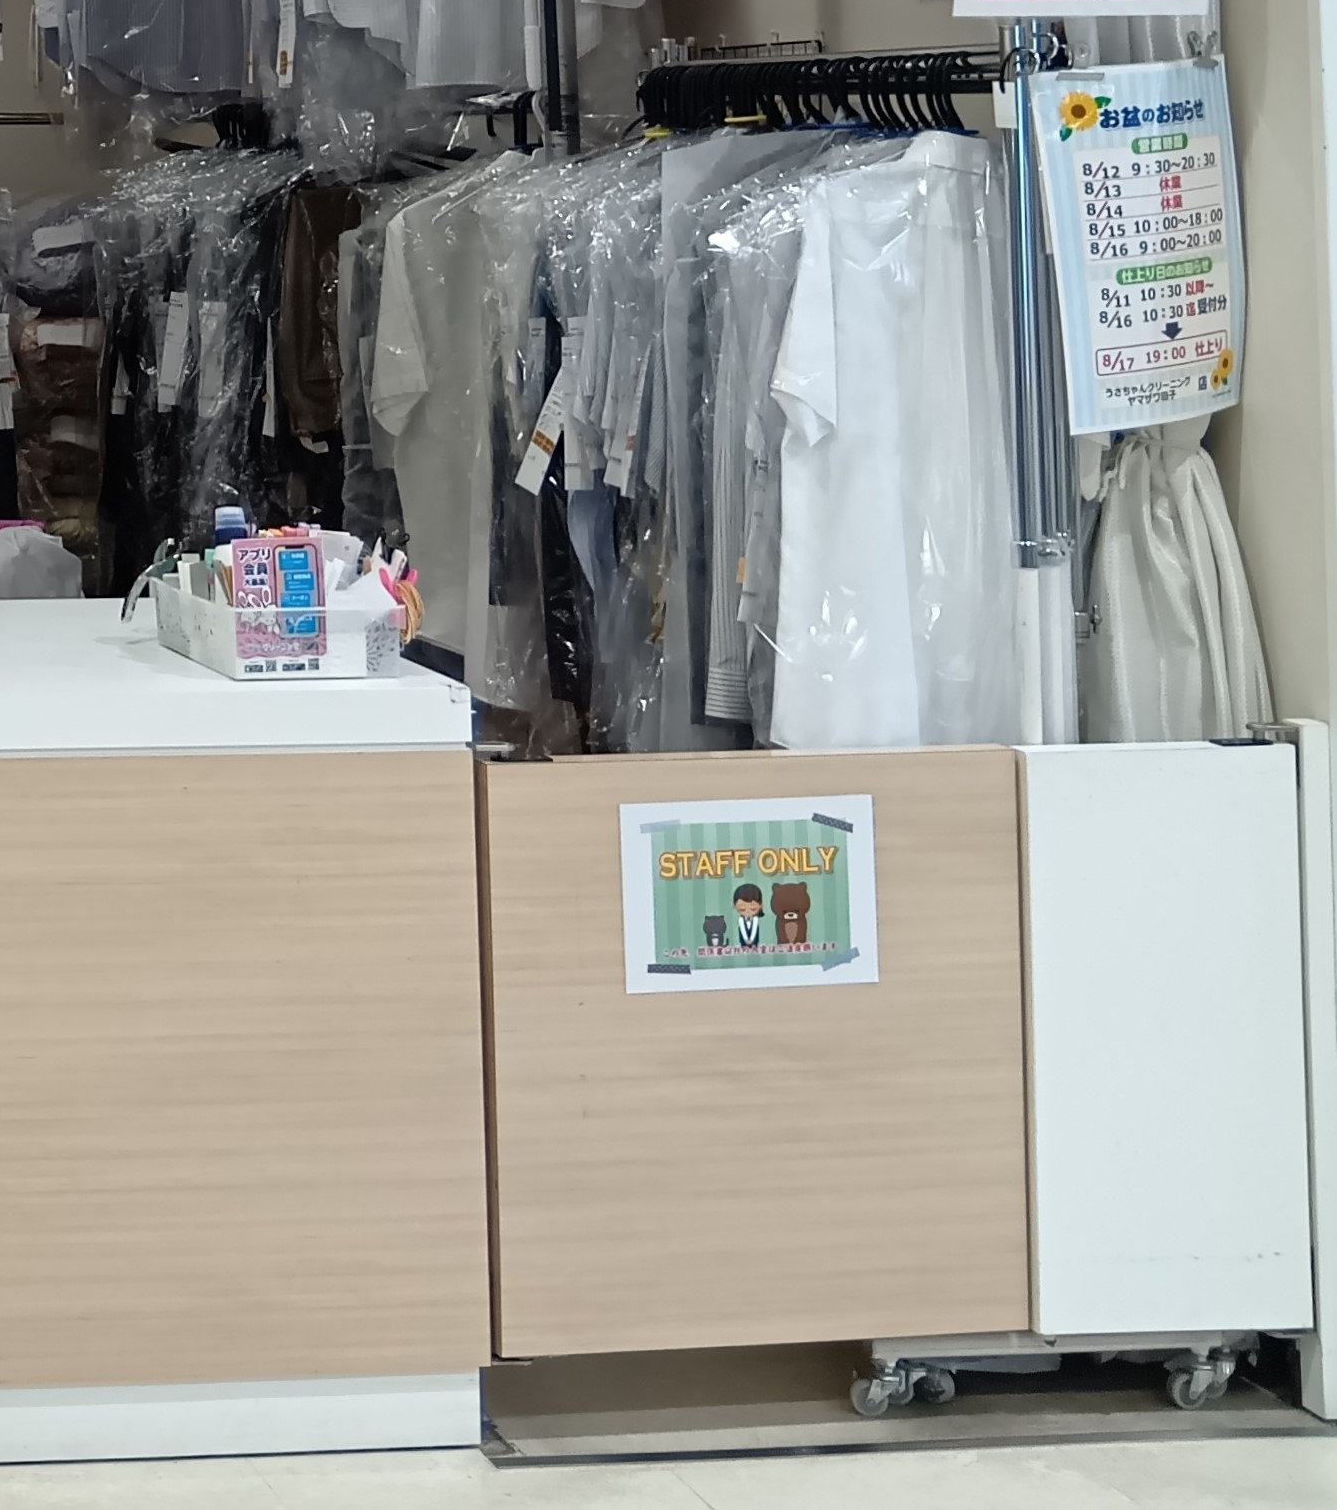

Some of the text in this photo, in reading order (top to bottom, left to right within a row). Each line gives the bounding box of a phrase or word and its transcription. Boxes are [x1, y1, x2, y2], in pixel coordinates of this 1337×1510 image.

[1099, 98, 1205, 130] お盆のお知らせ
[1082, 162, 1121, 180] 8/12
[1084, 176, 1182, 198] 8/13 休業
[1086, 195, 1183, 219] 8/14 休業
[1088, 222, 1126, 239] 8/15
[1090, 241, 1129, 258] 8/16
[1121, 259, 1211, 284] 仕上り日のお知らせ
[1100, 282, 1182, 309] 8/11 10:30
[1099, 294, 1227, 329] 8/16 10:30 受付分
[1101, 336, 1224, 372] 8/17 19:00 仕上り
[1105, 375, 1207, 399] うさちゃんクリーニング 店
[238, 548, 271, 561] アプリ
[243, 562, 269, 576] 会員
[658, 845, 839, 880] STAFF ONLY
